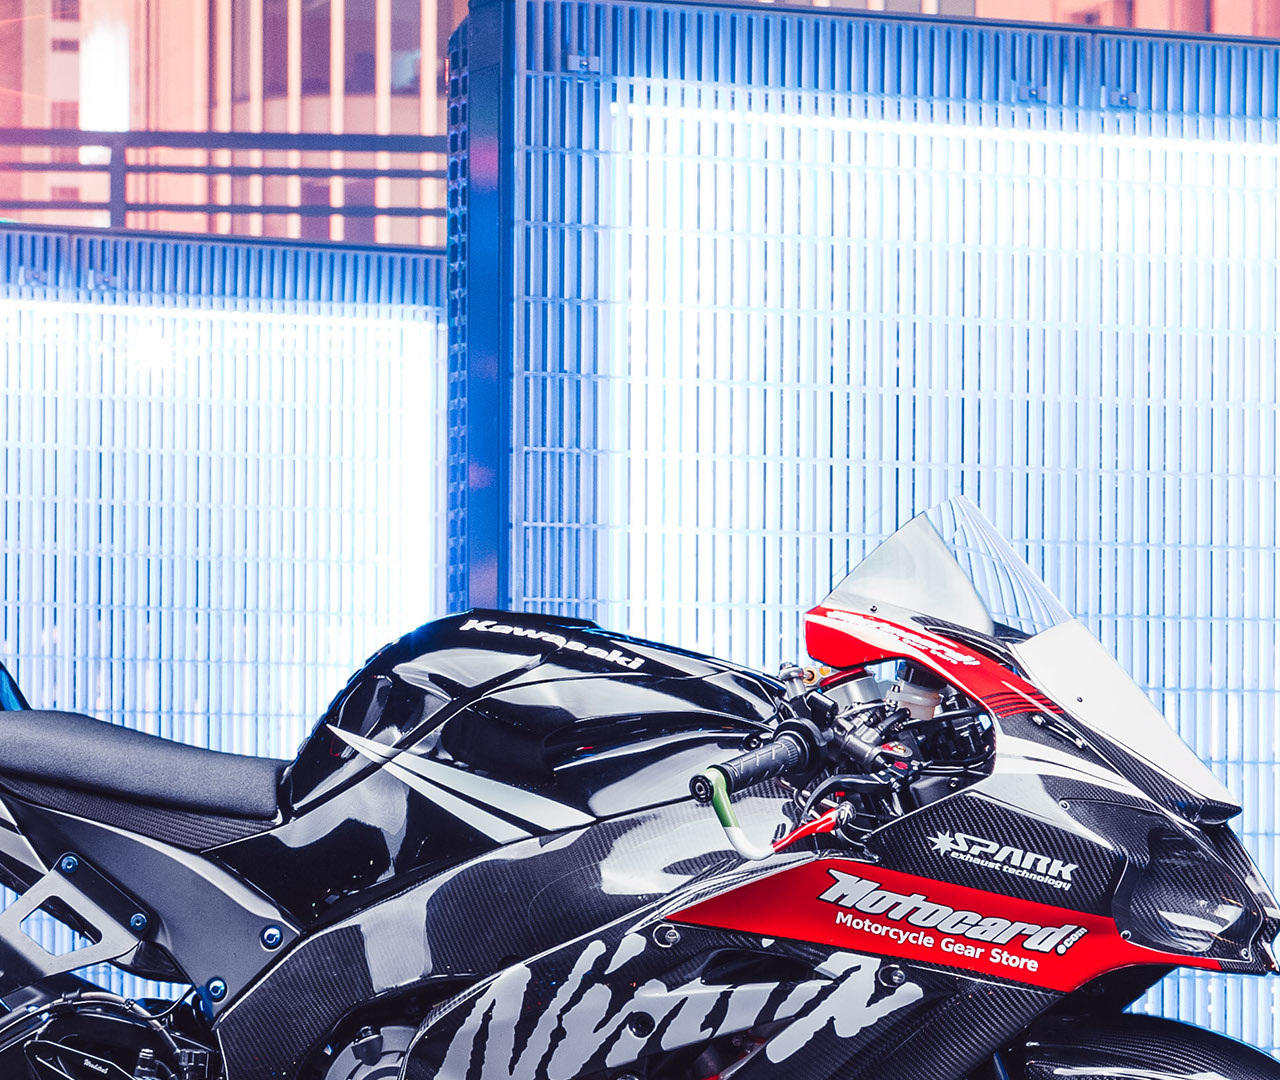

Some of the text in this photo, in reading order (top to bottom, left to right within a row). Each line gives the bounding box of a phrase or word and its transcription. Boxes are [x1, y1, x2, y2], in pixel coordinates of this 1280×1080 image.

[459, 619, 645, 669] Kawasaki
[949, 832, 1079, 881] SPARK
[950, 850, 1072, 891] exhaust technology
[835, 911, 1039, 972] Motorcycle Gear Store
